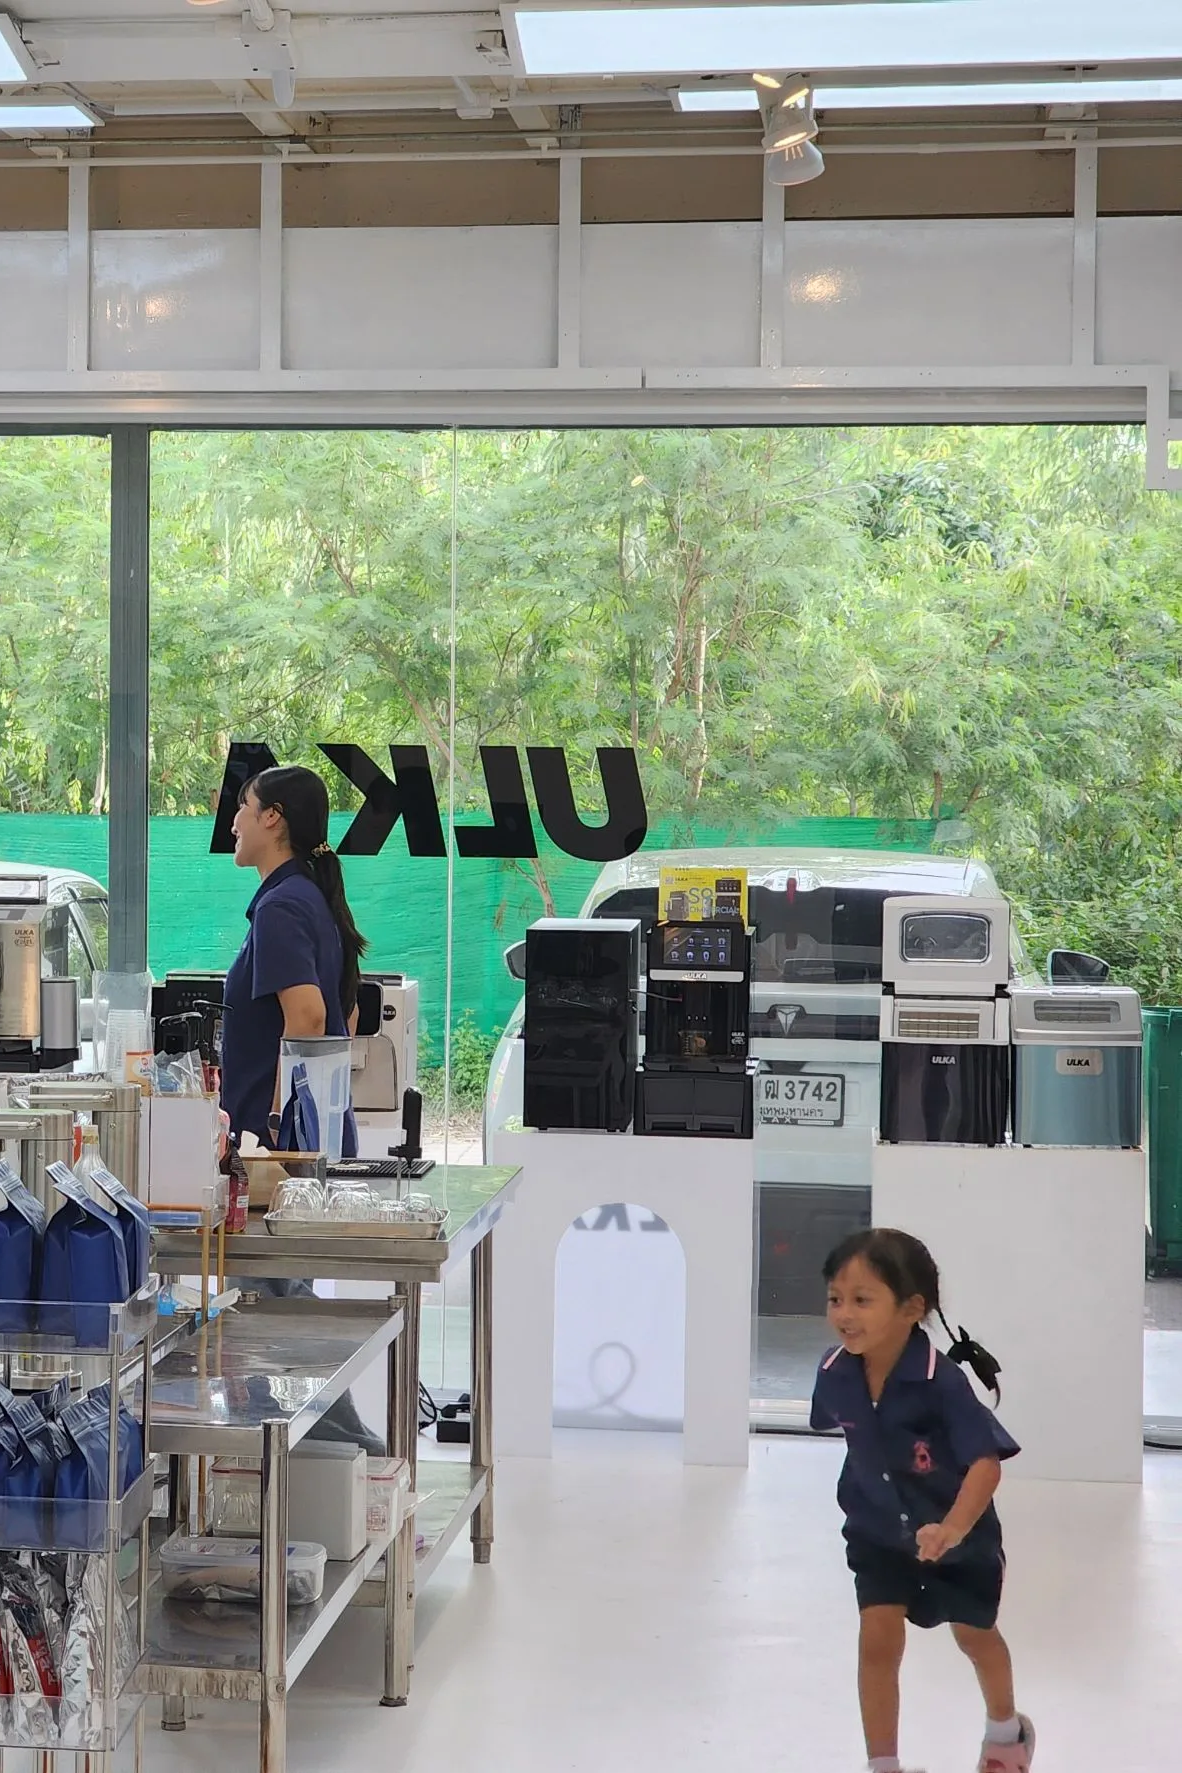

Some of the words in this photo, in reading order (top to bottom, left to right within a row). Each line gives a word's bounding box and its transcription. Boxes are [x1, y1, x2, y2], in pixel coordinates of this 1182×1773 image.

[931, 1055, 956, 1065] ULKA
[1066, 1058, 1091, 1067] ULKA
[784, 1080, 838, 1102] 3742
